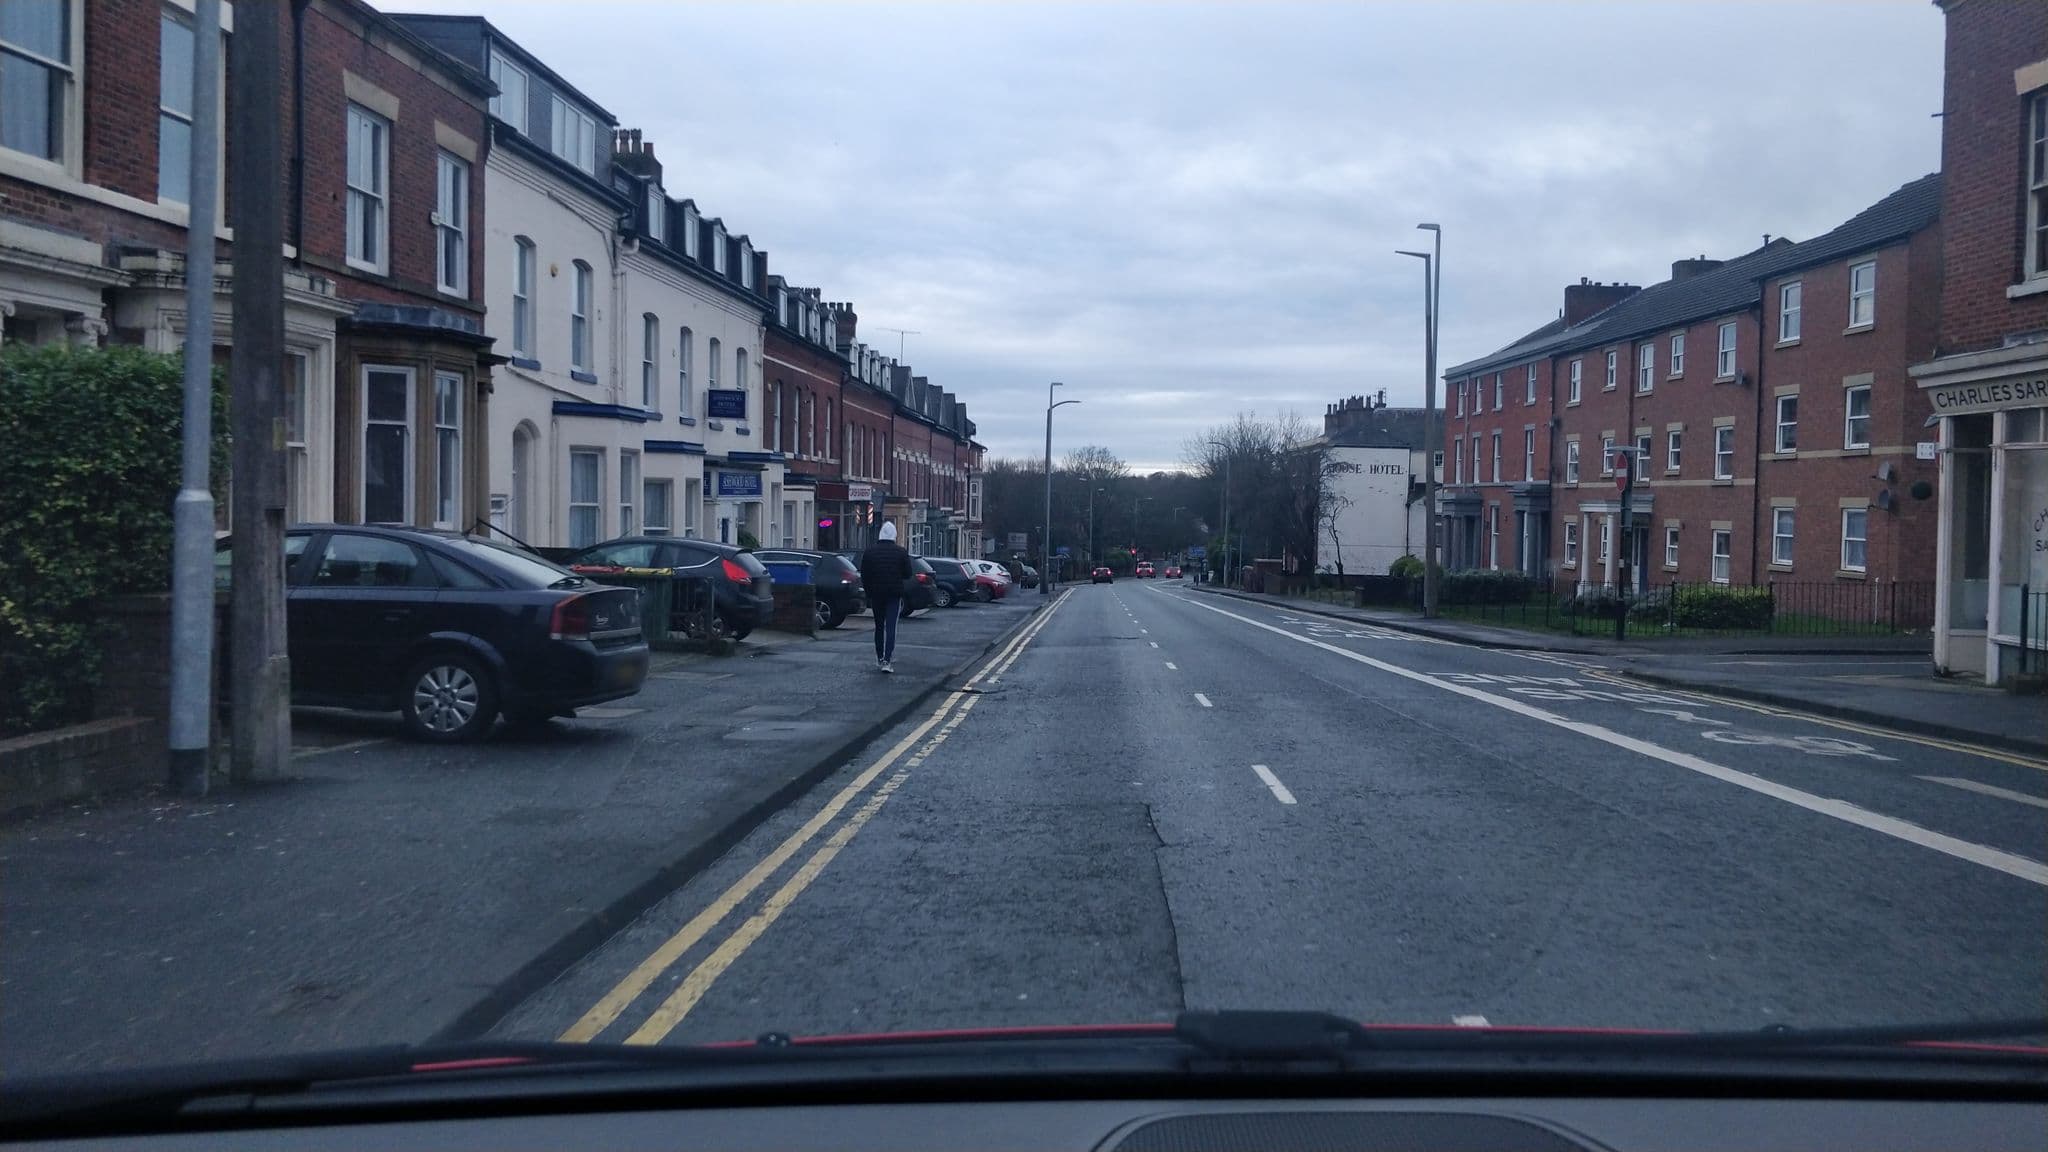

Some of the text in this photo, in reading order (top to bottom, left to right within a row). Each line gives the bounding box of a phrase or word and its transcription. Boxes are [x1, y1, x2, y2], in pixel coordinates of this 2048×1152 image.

[1936, 384, 2012, 408] CHARLIES
[1369, 464, 1404, 475] HOTEL
[1506, 687, 1710, 707] BUS
